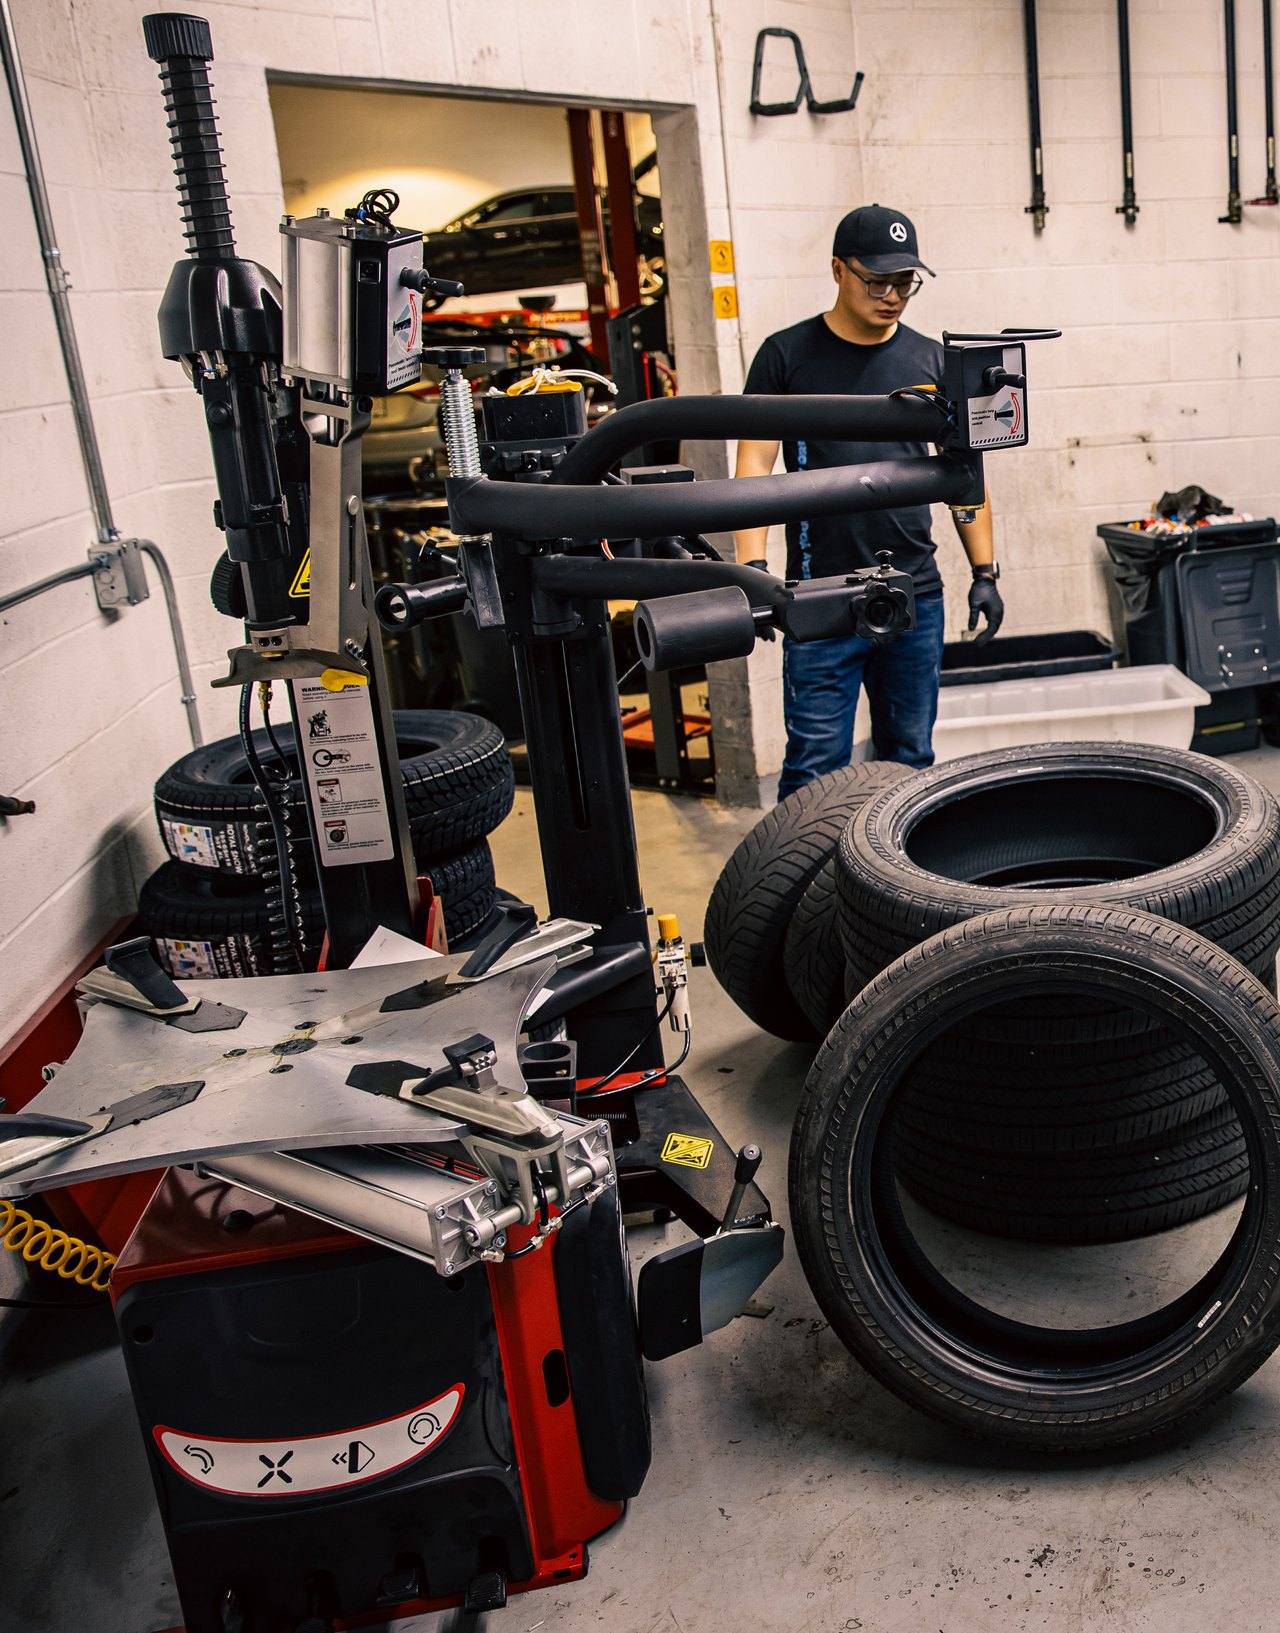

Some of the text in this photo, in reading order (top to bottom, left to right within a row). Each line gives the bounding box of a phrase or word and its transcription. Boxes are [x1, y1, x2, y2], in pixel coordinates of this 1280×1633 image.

[226, 823, 244, 875] ROYAL SNOW
[227, 936, 244, 978] ROYAL SNO
